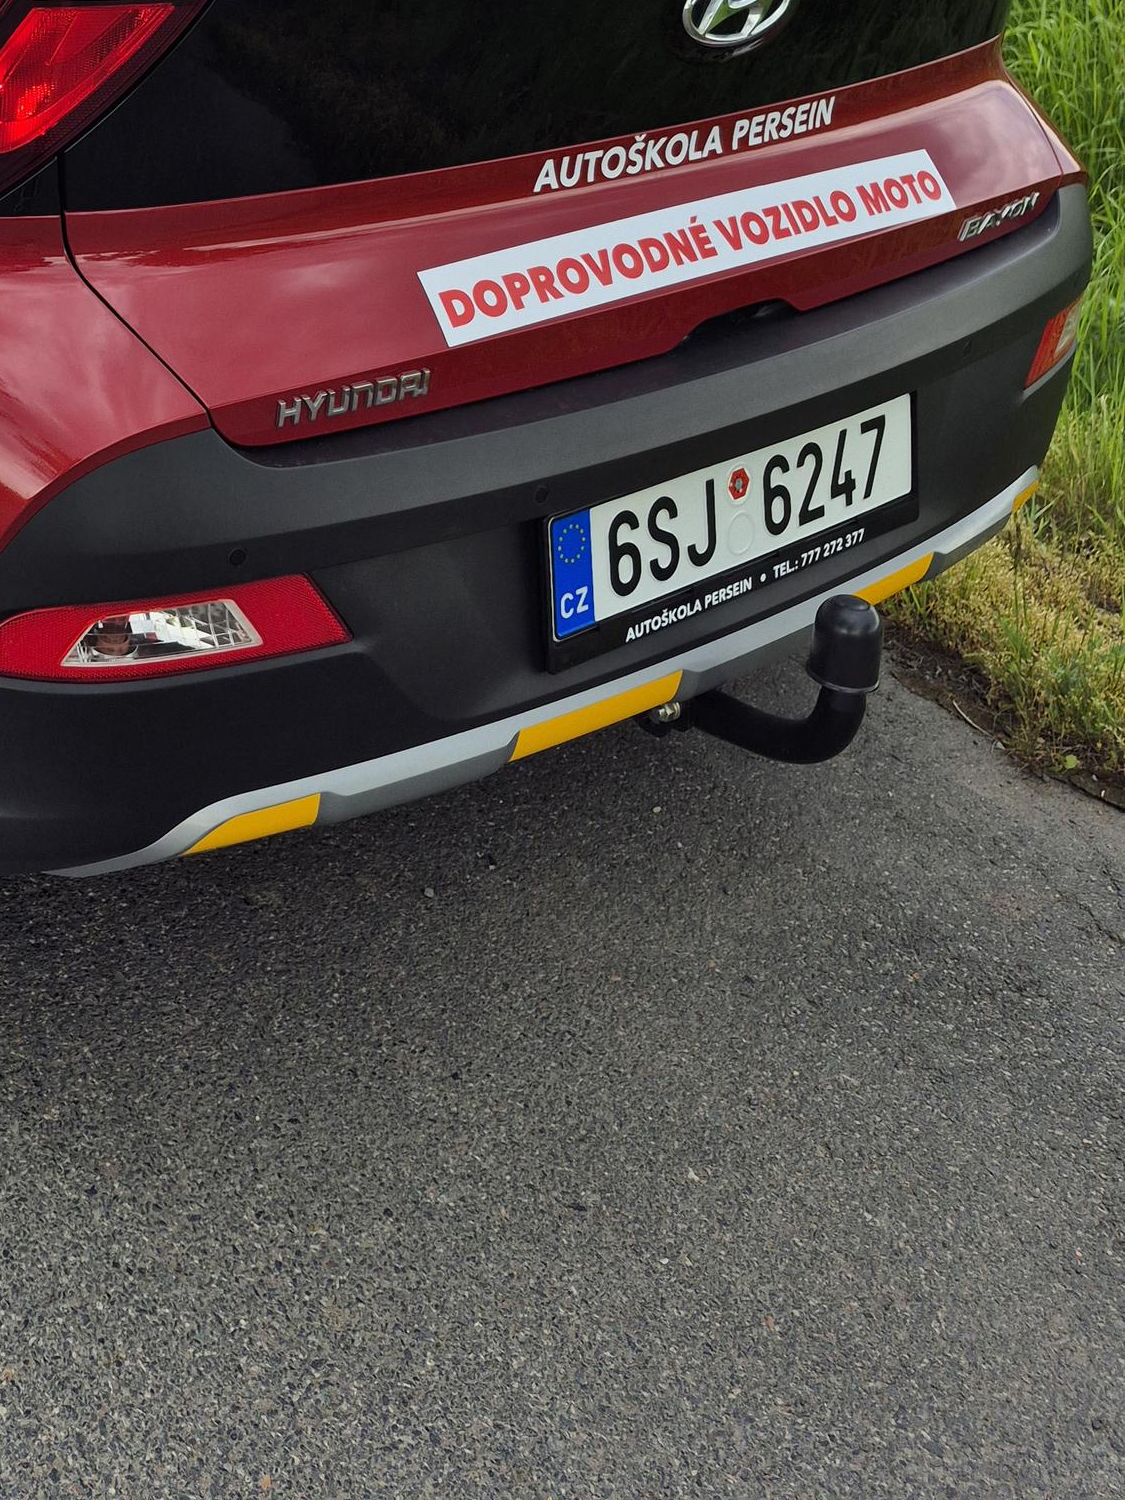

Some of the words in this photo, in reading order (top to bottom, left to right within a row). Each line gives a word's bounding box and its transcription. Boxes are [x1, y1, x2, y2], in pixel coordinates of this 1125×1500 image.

[532, 125, 723, 194] AUTOŠKOLA
[730, 96, 836, 152] PERSEIN
[439, 216, 719, 329] DOPROVODNÉ
[713, 190, 857, 252] VOZIDLO
[863, 170, 942, 217] MOTO
[277, 368, 431, 428] HYUNDAI
[608, 478, 717, 597] 6SJ
[762, 414, 886, 536] 6247
[560, 585, 589, 620] CZ
[625, 598, 702, 643] AUTOŠKOLA
[704, 577, 752, 609] PERSEIN
[773, 558, 798, 580] TEL.:
[801, 547, 821, 567] 777
[823, 539, 843, 558] 272
[844, 528, 865, 549] 377
